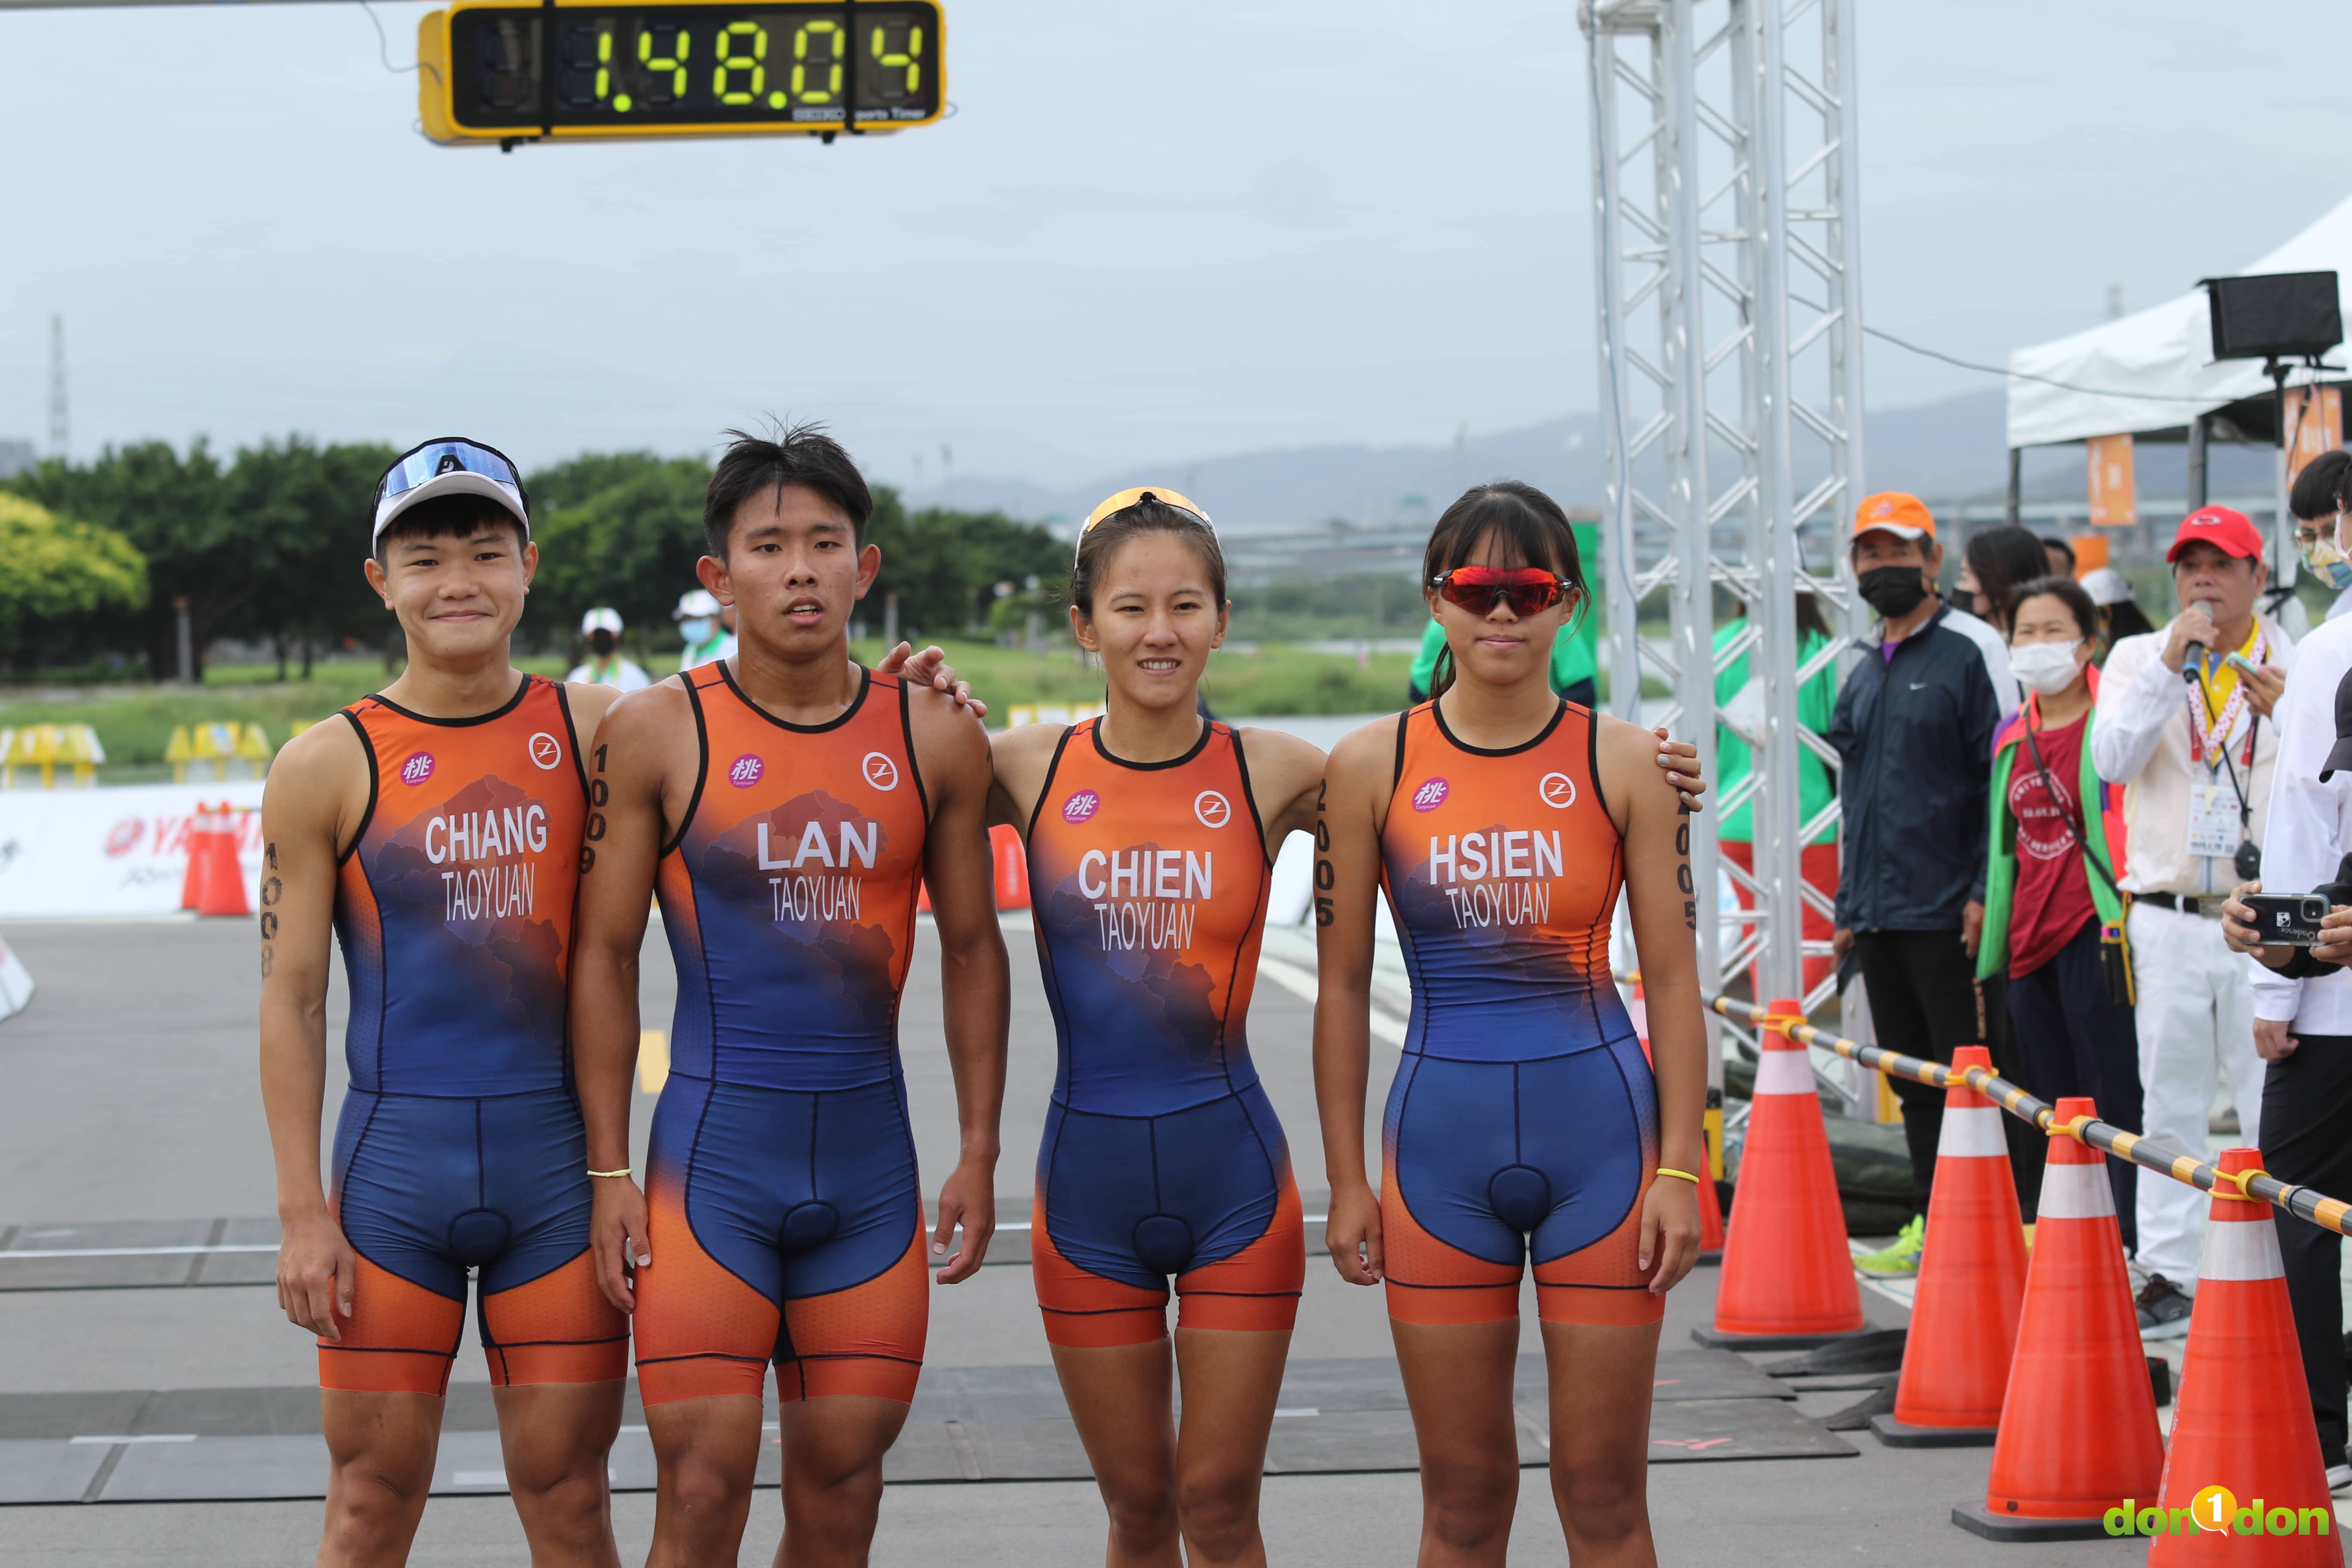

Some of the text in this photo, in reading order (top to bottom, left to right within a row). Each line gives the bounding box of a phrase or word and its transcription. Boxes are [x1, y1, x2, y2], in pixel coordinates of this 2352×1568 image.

[402, 755, 433, 780] 桃
[730, 759, 762, 780] 桃
[1064, 794, 1097, 815] 桃
[1414, 782, 1447, 805] 桃
[426, 805, 547, 864] CHIANG
[757, 821, 877, 871] LAN
[1316, 778, 1335, 927] 2005
[1430, 830, 1564, 885] HSIEN
[441, 862, 534, 921] TAOYUAN
[769, 876, 862, 922] TAOYUAN
[1078, 849, 1212, 900] CHIEN
[1094, 901, 1195, 951] TAOYUAN
[1445, 882, 1550, 929] TAOYUAN
